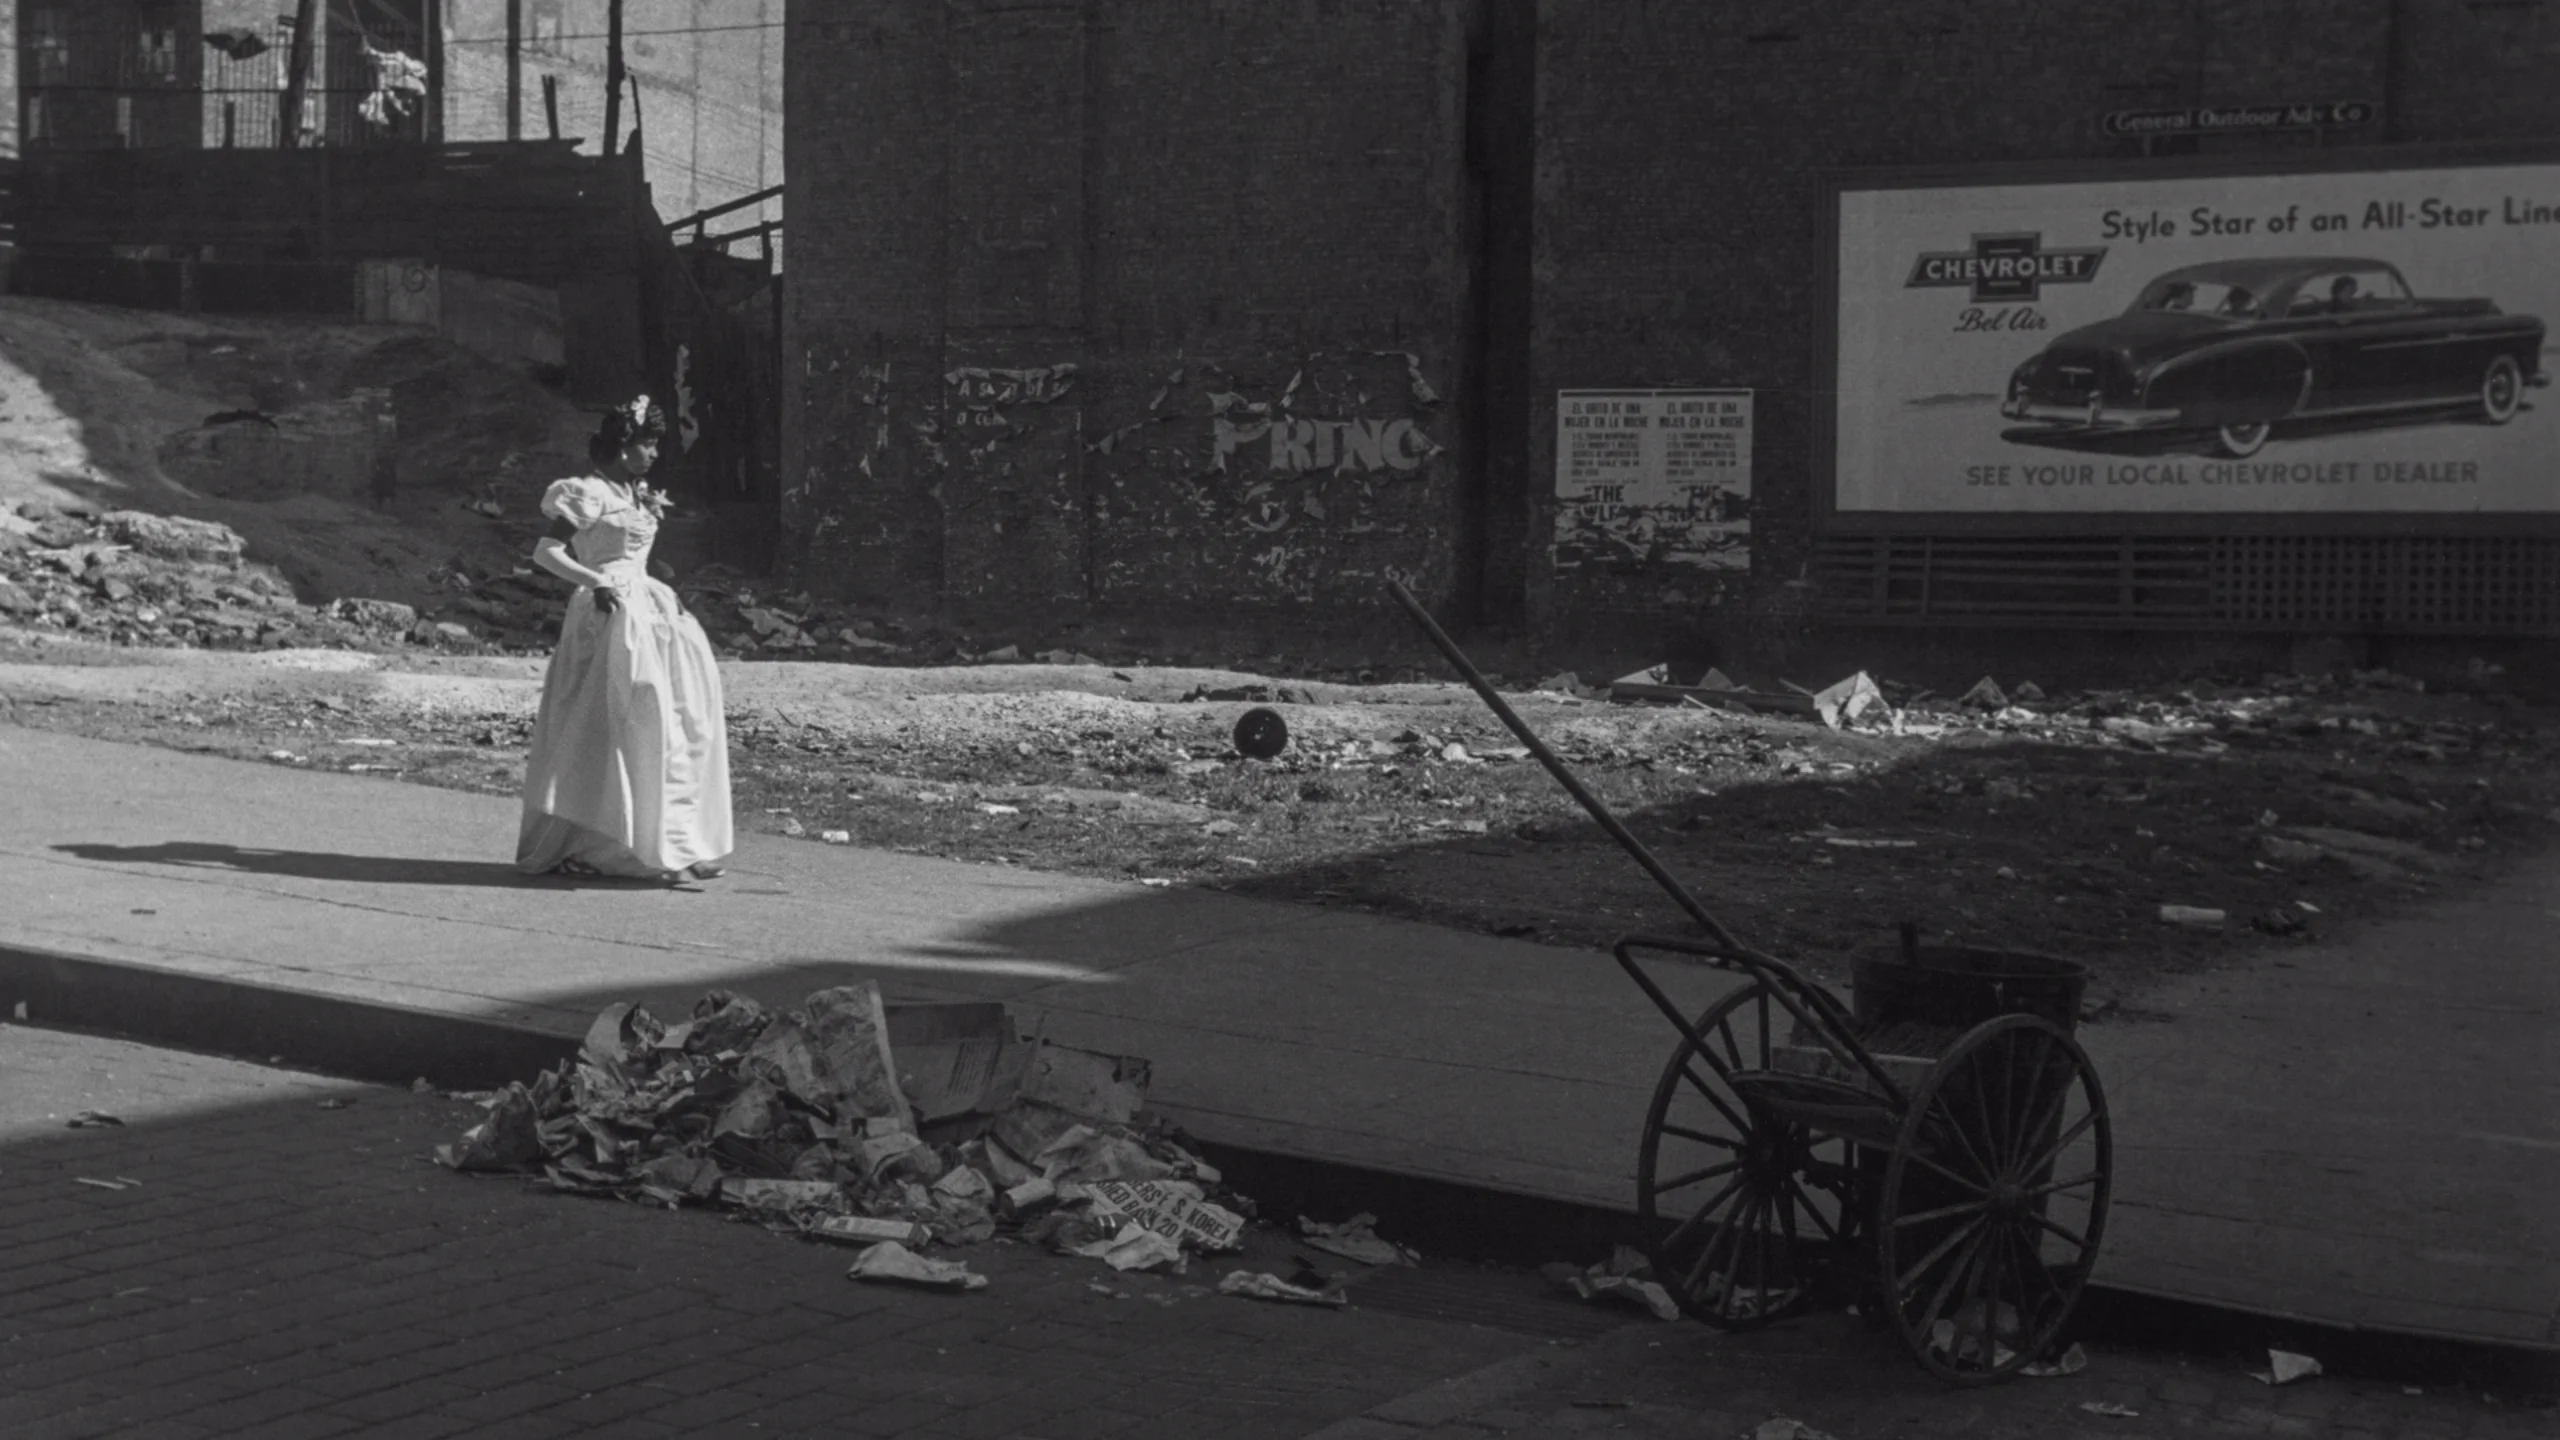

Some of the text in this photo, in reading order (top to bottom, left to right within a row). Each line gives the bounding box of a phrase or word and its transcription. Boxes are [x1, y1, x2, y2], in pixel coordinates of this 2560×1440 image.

[2116, 112, 2191, 130] General
[2198, 109, 2282, 126] Outdoor
[2101, 209, 2175, 244] Style
[2190, 207, 2256, 236] Star
[2267, 204, 2300, 234] of
[2310, 213, 2349, 232] an
[2361, 198, 2491, 230] All-Star
[1926, 255, 2084, 279] CHEVROLET
[1952, 307, 2049, 332] Bel Air
[1564, 416, 1648, 429] MUJER EN LA NOCHE
[1659, 416, 1743, 429] MUJER EN LA NOCHE
[1966, 462, 2479, 486] SEE YOUR LOCAL CHEVROLET DEALER
[1155, 1217, 1180, 1239] 20
[1172, 1199, 1187, 1219] S.
[1185, 1207, 1231, 1241] KOREA
